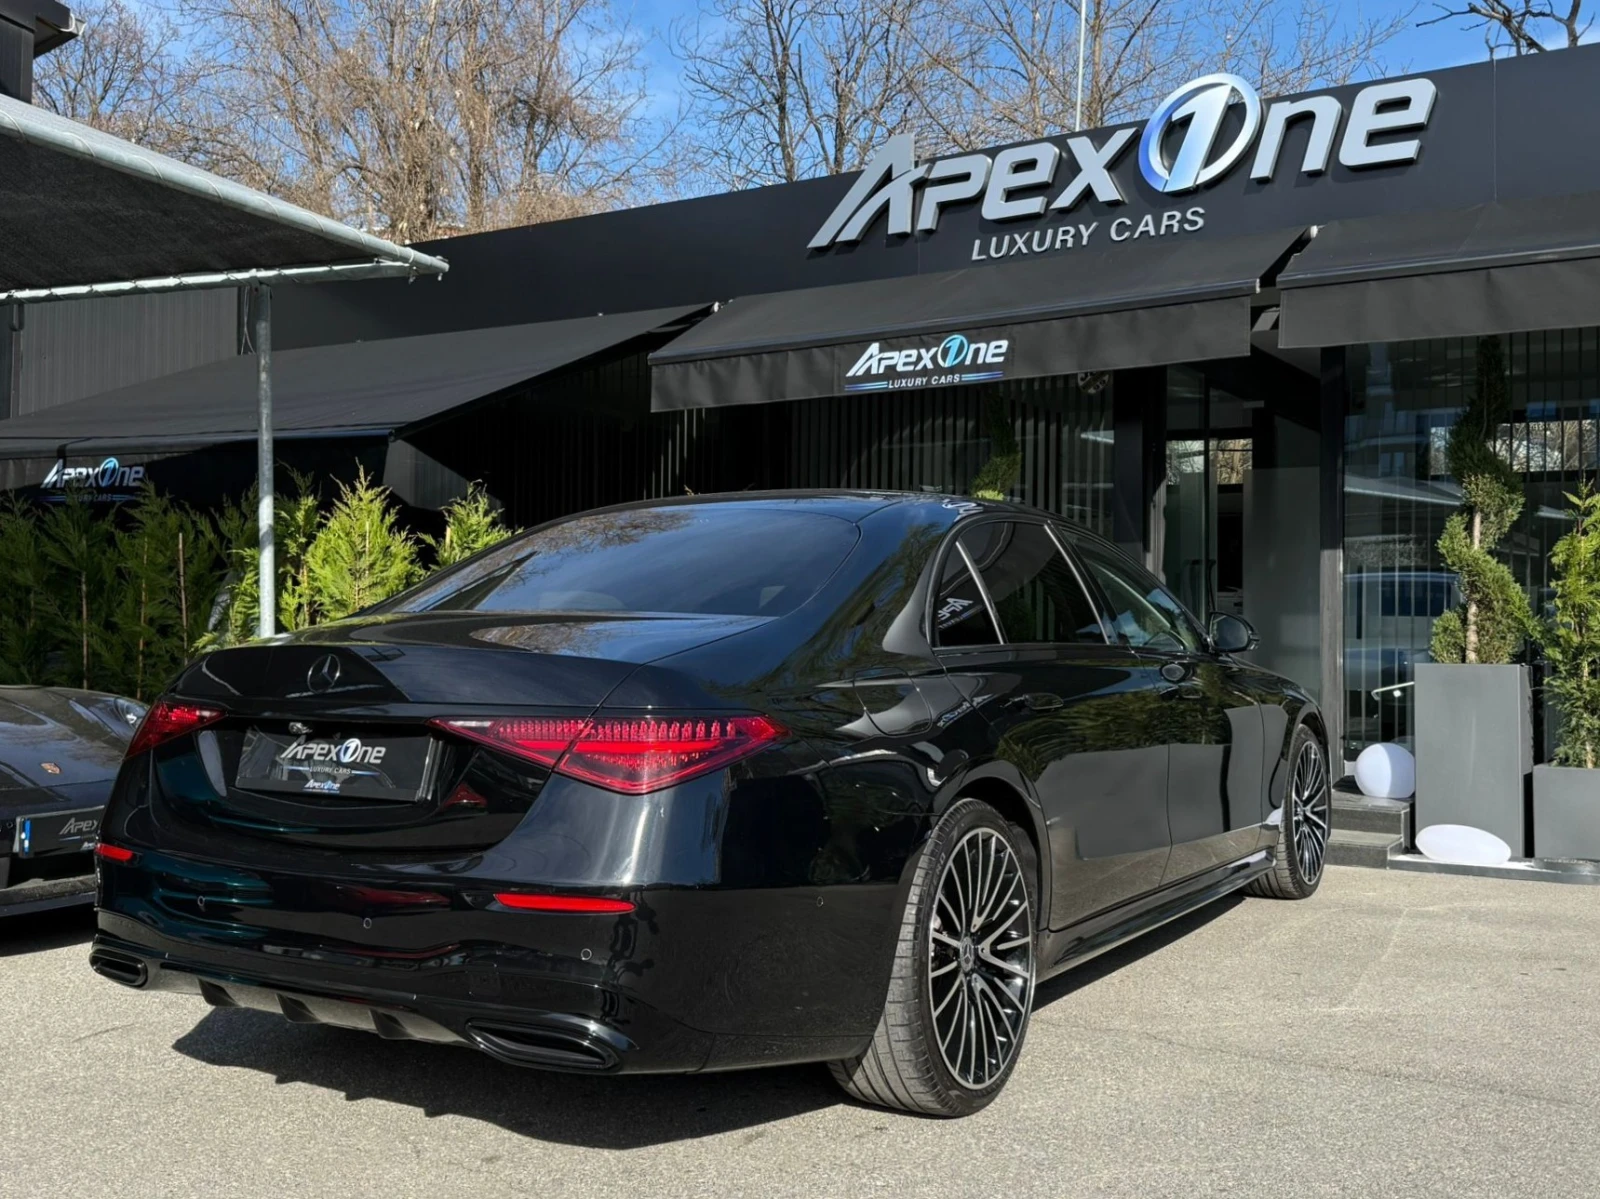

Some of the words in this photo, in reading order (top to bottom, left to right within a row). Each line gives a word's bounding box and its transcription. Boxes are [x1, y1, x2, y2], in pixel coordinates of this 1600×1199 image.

[971, 221, 1099, 261] LUXURY
[1109, 206, 1206, 242] CARS
[888, 377, 928, 389] LUXURY
[931, 374, 960, 385] CARS
[309, 766, 332, 774] LUXURY
[334, 767, 351, 775] CARS
